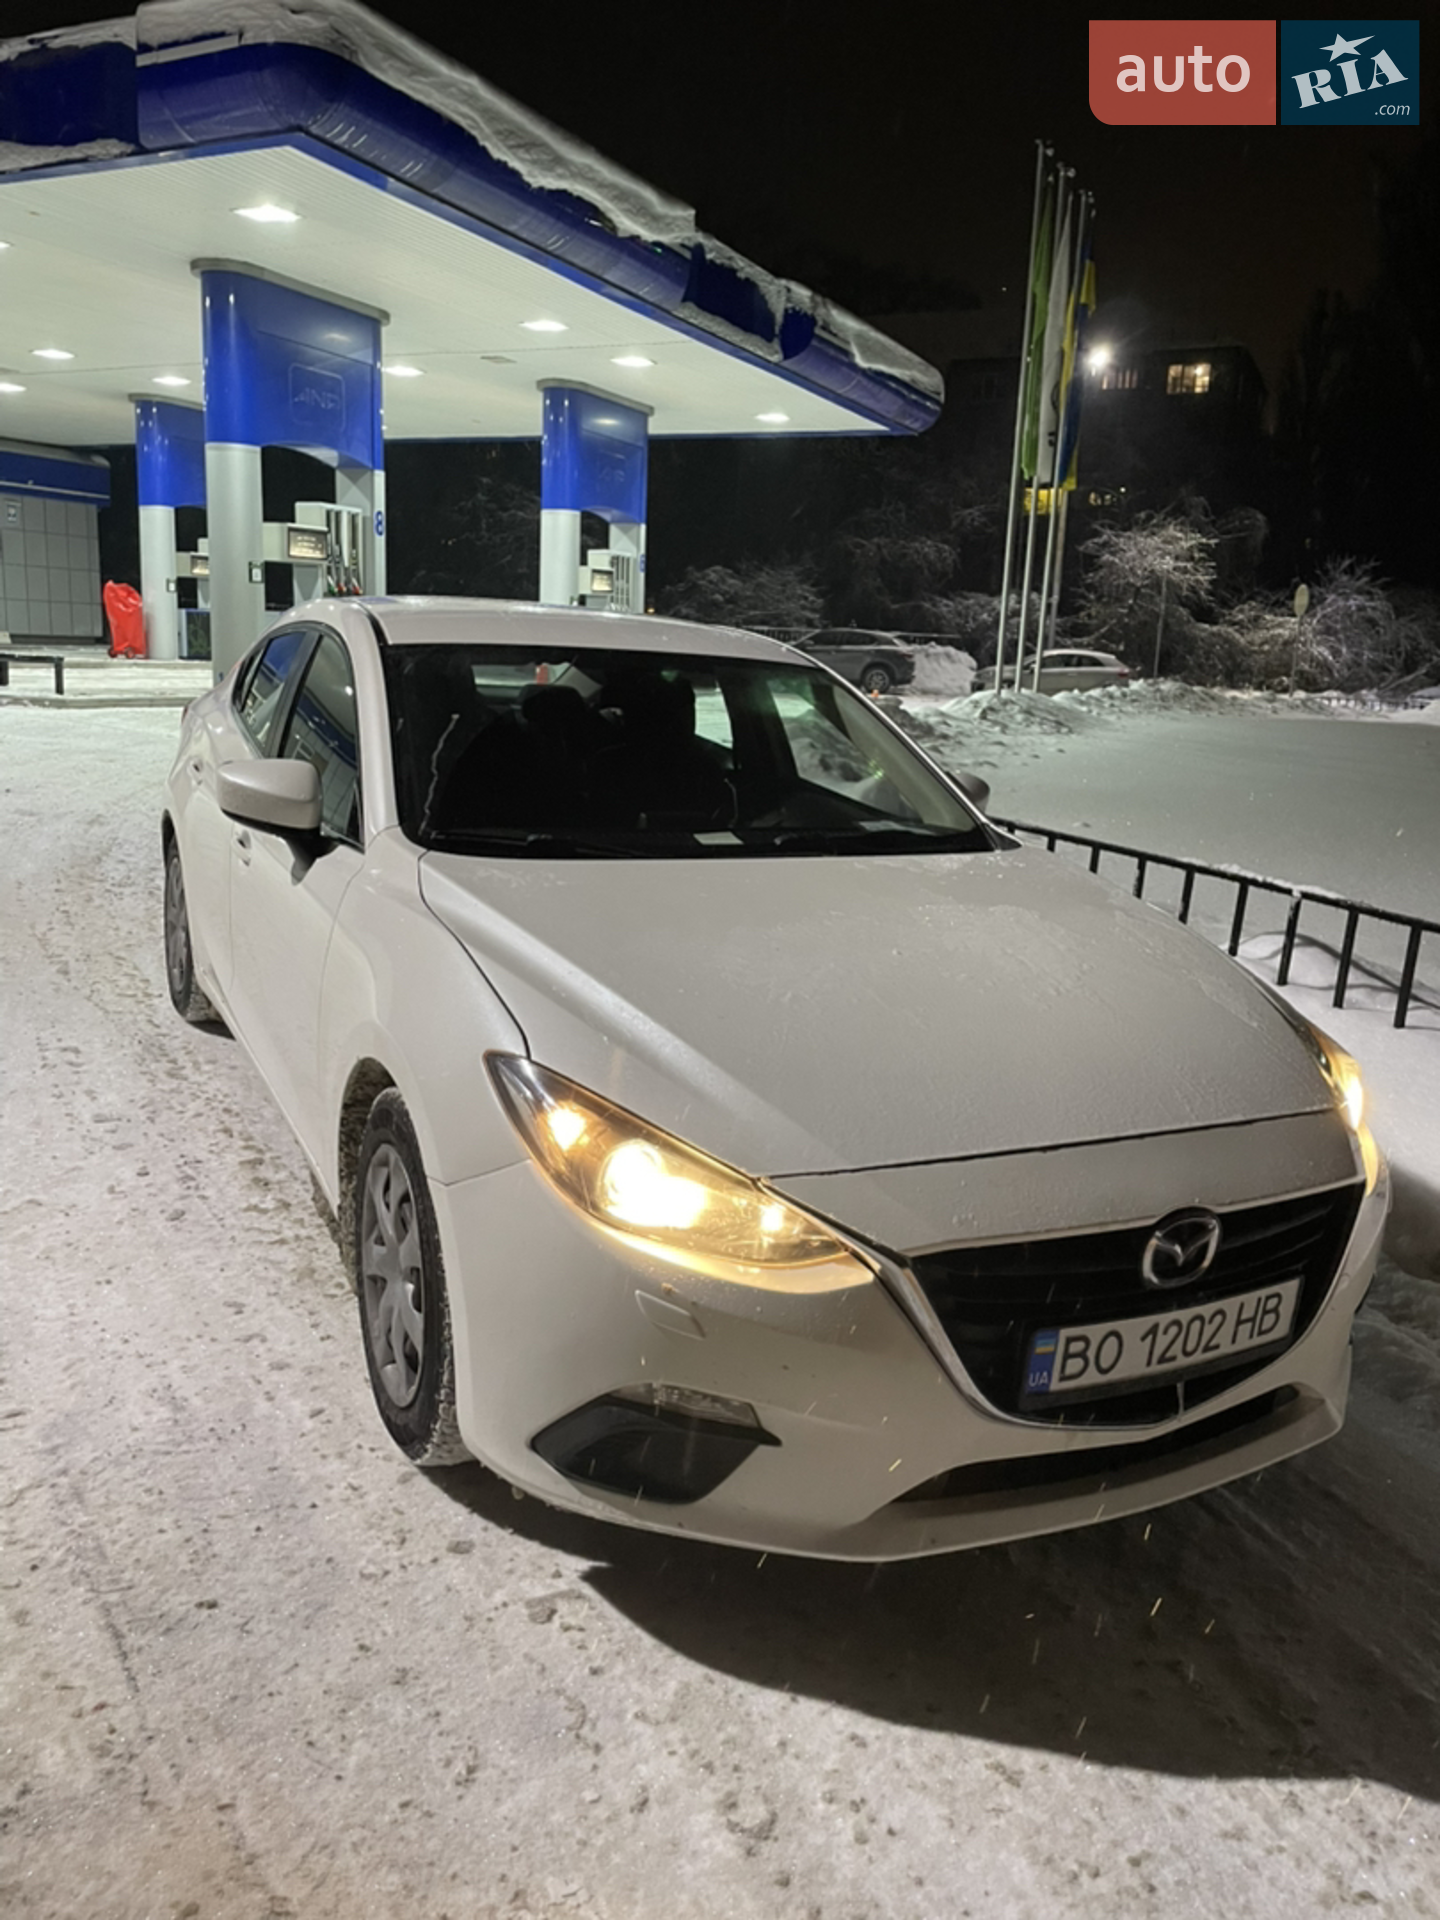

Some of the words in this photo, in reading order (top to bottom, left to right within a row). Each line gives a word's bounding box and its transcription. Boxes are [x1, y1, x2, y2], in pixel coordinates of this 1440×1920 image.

[1058, 1329, 1124, 1383] BO
[1140, 1308, 1227, 1368] 1202
[1231, 1291, 1283, 1345] HB
[1028, 1371, 1049, 1388] UA
